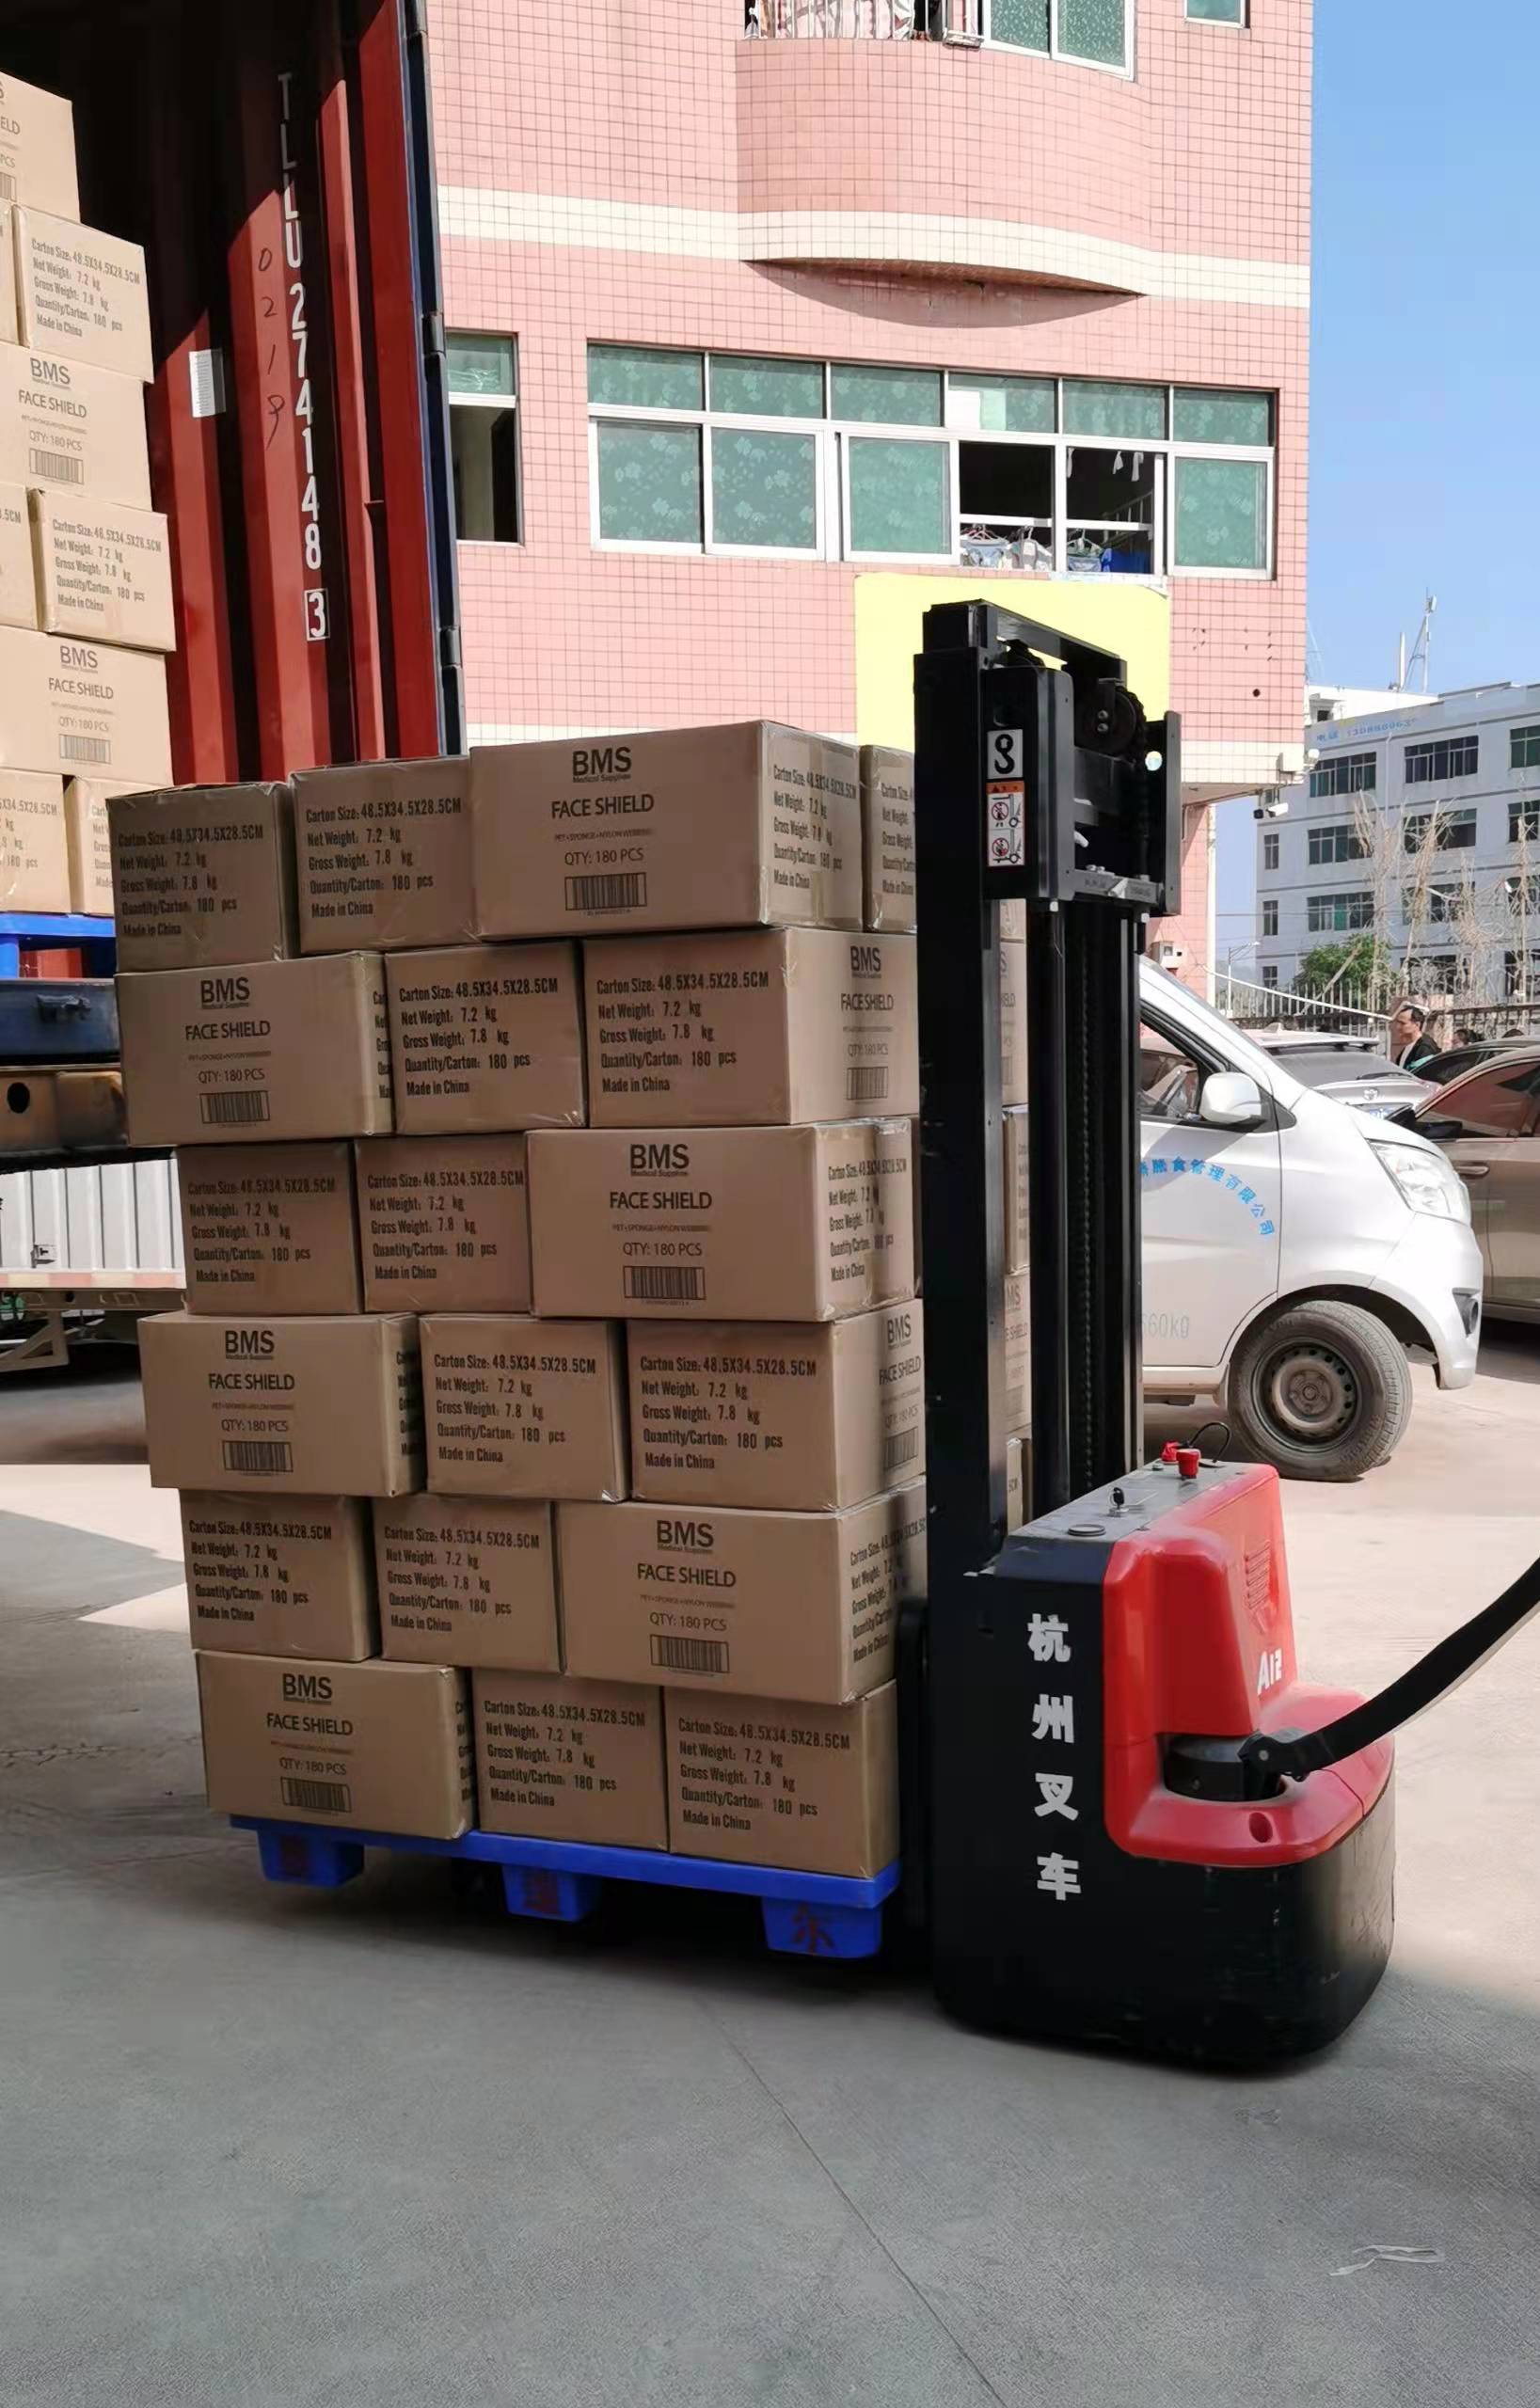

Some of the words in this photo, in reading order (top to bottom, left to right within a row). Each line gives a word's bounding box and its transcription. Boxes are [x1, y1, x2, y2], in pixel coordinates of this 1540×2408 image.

[30, 357, 71, 384] BMS
[19, 389, 46, 408] FACE
[49, 398, 87, 418] SHIELD
[30, 430, 48, 443] QTY:
[51, 436, 65, 447] 180
[67, 439, 83, 451] PCS
[53, 519, 75, 533] Carton
[55, 538, 67, 549] Net
[98, 547, 110, 559] 7.2
[115, 549, 123, 563] kg
[56, 557, 74, 570] Gross
[105, 563, 116, 577] 7.8
[123, 569, 132, 582] kg
[58, 594, 75, 607] Made
[78, 597, 84, 608] in
[86, 597, 103, 611] China
[118, 587, 129, 599] 180
[134, 591, 145, 601] pcs
[60, 645, 98, 668] BMS
[49, 677, 75, 694] FACE
[77, 682, 114, 699] SHIELD
[59, 716, 77, 727] QTY:
[79, 719, 93, 730] 180
[95, 721, 109, 732] PCS
[573, 747, 632, 776] BMS
[306, 809, 336, 823] Carton
[361, 798, 462, 818] 48.5X34.5X28.5CM
[551, 799, 592, 818] FACE
[595, 794, 655, 816] SHIELD
[308, 832, 323, 847] Net
[366, 828, 382, 843] 7.2
[390, 826, 401, 843] kg
[309, 856, 333, 870] Gross
[375, 849, 390, 865] 7.8
[401, 850, 413, 866] kg
[564, 851, 593, 865] QTY:
[596, 850, 617, 863] 180
[621, 848, 644, 863] PCS
[392, 875, 410, 890] 180
[417, 875, 433, 890] pcs
[311, 903, 335, 917] Made
[338, 902, 345, 915] in
[348, 901, 373, 915] China
[850, 945, 881, 972] BMS
[200, 977, 249, 1003] BMS
[597, 979, 630, 994] Carton
[659, 972, 769, 990] 48.5X34.5X28.5CM
[598, 1005, 615, 1020] Net
[663, 1001, 680, 1016] 7.2
[690, 1000, 701, 1017] kg
[841, 993, 864, 1011] FACE
[865, 993, 894, 1011] SHIELD
[185, 1024, 218, 1040] FACE
[221, 1021, 270, 1038] SHIELD
[600, 1029, 627, 1043] Gross
[673, 1024, 690, 1038] 7.8
[702, 1025, 714, 1041] kg
[692, 1051, 710, 1066] 180
[719, 1052, 737, 1067] pcs
[198, 1071, 220, 1084] QTY:
[225, 1069, 242, 1082] 180
[245, 1069, 265, 1080] PCS
[603, 1078, 628, 1092] Made
[631, 1078, 639, 1091] in
[643, 1077, 670, 1091] China
[630, 1144, 689, 1169] BMS
[610, 1192, 649, 1209] FACE
[653, 1192, 712, 1210] SHIELD
[623, 1243, 650, 1255] QTY:
[654, 1244, 675, 1256] 180
[679, 1244, 702, 1256] PCS
[226, 1330, 274, 1354] BMS
[641, 1356, 674, 1371] Carton
[704, 1357, 817, 1375] 48.5X34.5X28.5CM
[209, 1373, 242, 1389] FACE
[246, 1373, 294, 1390] SHIELD
[642, 1381, 659, 1395] Net
[708, 1383, 725, 1397] 7.2
[736, 1383, 748, 1400] kg
[643, 1405, 670, 1419] Gross
[718, 1405, 736, 1420] 7.8
[747, 1407, 759, 1425] kg
[221, 1419, 245, 1432] QTY:
[248, 1420, 265, 1431] 180
[268, 1421, 288, 1432] PCS
[738, 1433, 757, 1449] 180
[765, 1434, 783, 1450] pcs
[645, 1452, 671, 1467] Made
[675, 1454, 683, 1467] in
[686, 1454, 714, 1468] China
[657, 1520, 714, 1547] BMS
[637, 1563, 675, 1582] FACE
[679, 1567, 736, 1587] SHIELD
[650, 1612, 676, 1625] QTY:
[680, 1616, 700, 1628] 180
[704, 1618, 727, 1631] PCS
[283, 1673, 332, 1699] BMS
[484, 1701, 515, 1715] Carton
[542, 1704, 645, 1726] 48.5X34.5X28.5CM
[266, 1713, 299, 1731] FACE
[303, 1717, 353, 1735] SHIELD
[486, 1722, 501, 1736] Net
[548, 1727, 564, 1742] 7.2
[572, 1730, 582, 1745] kg
[279, 1757, 303, 1769] QTY:
[306, 1761, 324, 1772] 180
[326, 1764, 346, 1775] PCS
[487, 1744, 513, 1759] Gross
[557, 1749, 572, 1763] 7.8
[583, 1752, 595, 1768] kg
[1027, 1613, 1081, 1901] 杭州叉车
[573, 1775, 592, 1790] 180
[599, 1779, 616, 1791] pcs
[491, 1788, 516, 1802] Made
[518, 1791, 527, 1803] in
[529, 1791, 554, 1806] China
